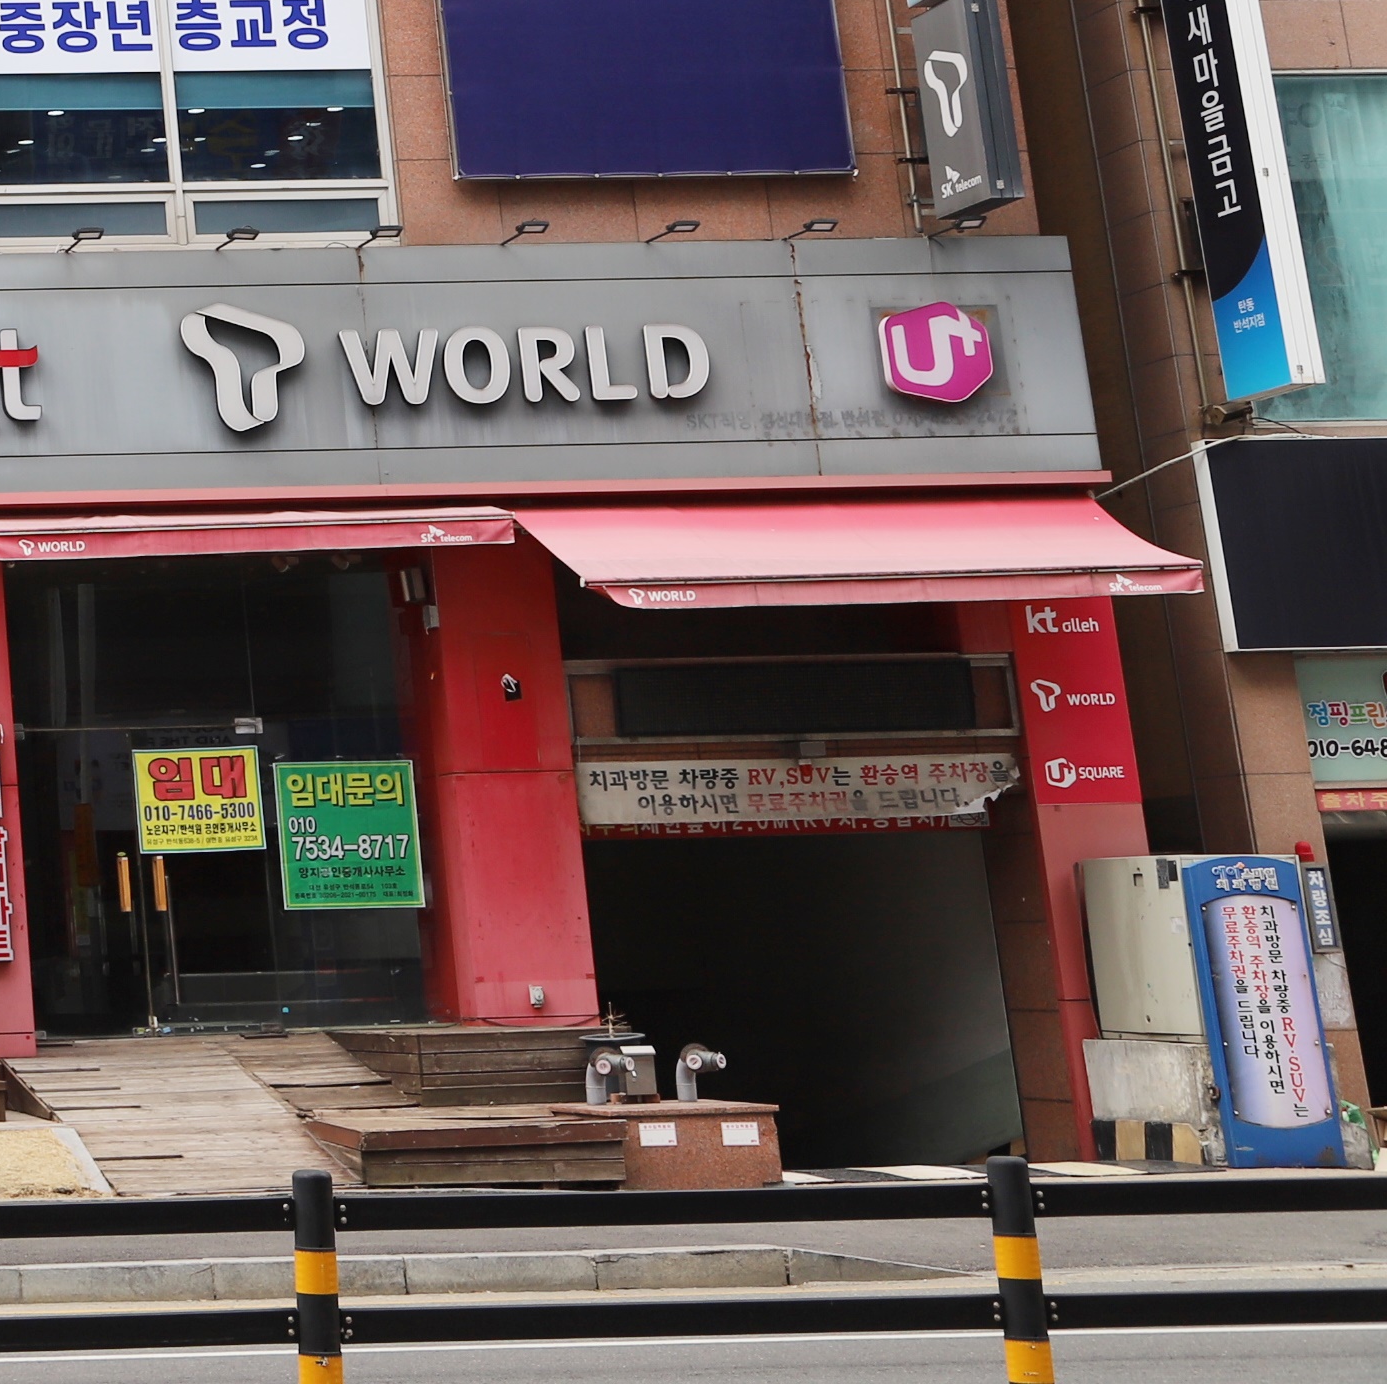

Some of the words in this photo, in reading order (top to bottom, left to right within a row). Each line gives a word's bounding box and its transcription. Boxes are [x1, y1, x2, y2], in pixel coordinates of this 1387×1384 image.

[940, 178, 955, 200] SK
[954, 172, 983, 194] telecom
[338, 322, 713, 407] WORLD
[38, 539, 86, 554] WORLD
[420, 532, 435, 544] SK
[440, 533, 474, 543] telecom
[647, 589, 697, 603] WORLD
[1109, 582, 1125, 592] SK
[1129, 584, 1163, 592] telecom
[1025, 605, 1058, 634] kt
[1062, 618, 1100, 633] olleh
[1066, 692, 1116, 706] WORLD
[147, 755, 248, 802] 임대
[588, 768, 670, 792] 치과방문
[677, 767, 740, 789] 차량중
[859, 764, 920, 787] 환승역
[1078, 766, 1126, 782] SQUARE
[286, 771, 405, 809] 임대문의
[637, 793, 740, 816] 이용하시면
[747, 789, 869, 813] 무료주차권을
[144, 802, 256, 822] 010-7466-5300
[288, 816, 317, 834] 010
[291, 834, 410, 861] 7534-8717
[1216, 878, 1279, 892] 치과병원
[1305, 869, 1334, 948] 차량조심
[1240, 904, 1262, 949] 환승역
[1259, 904, 1284, 965] 치과방문
[1221, 906, 1250, 994] 무료주차권을
[1237, 1000, 1261, 1059] 드립니다
[1249, 954, 1272, 1015] 주차장을
[1271, 969, 1292, 1015] 차량중
[1260, 1019, 1286, 1095] 이용하시면
